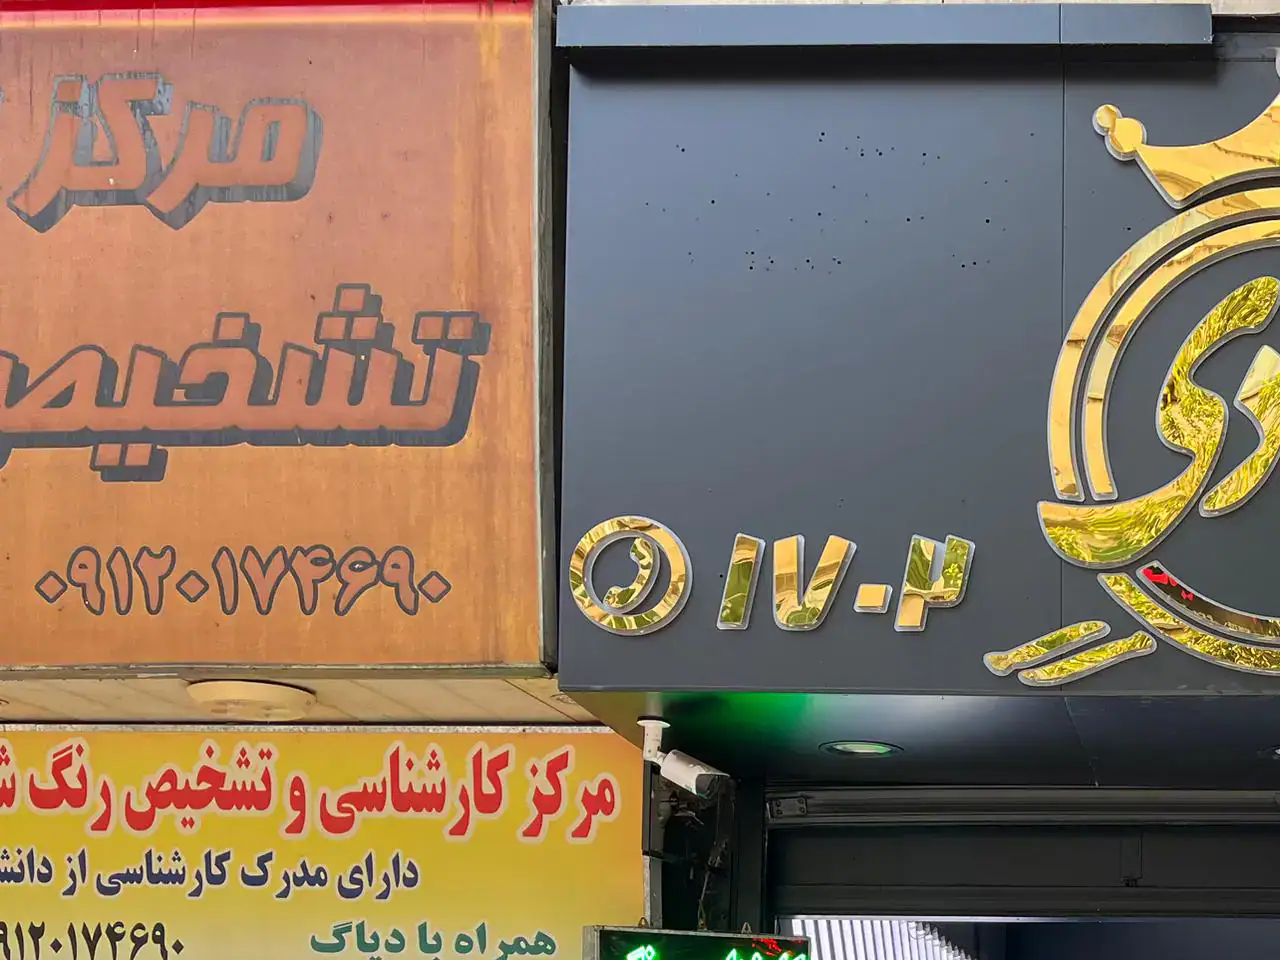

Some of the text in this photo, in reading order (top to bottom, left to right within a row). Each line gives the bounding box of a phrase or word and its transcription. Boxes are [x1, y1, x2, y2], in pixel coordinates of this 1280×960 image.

[6, 72, 323, 234] مرکز
[35, 544, 452, 616] ۰۹۱۲۰۱۷۴۶۹۰
[29, 744, 111, 831] رنگ
[125, 745, 272, 831] تشخیص
[286, 780, 307, 833] و
[320, 746, 509, 836] کارشناسی
[522, 750, 616, 838] مرکز
[62, 848, 87, 896] از
[96, 848, 231, 897] کارشناسی
[240, 852, 327, 898] مدرک
[336, 852, 420, 899] دارای
[417, 922, 443, 959] با
